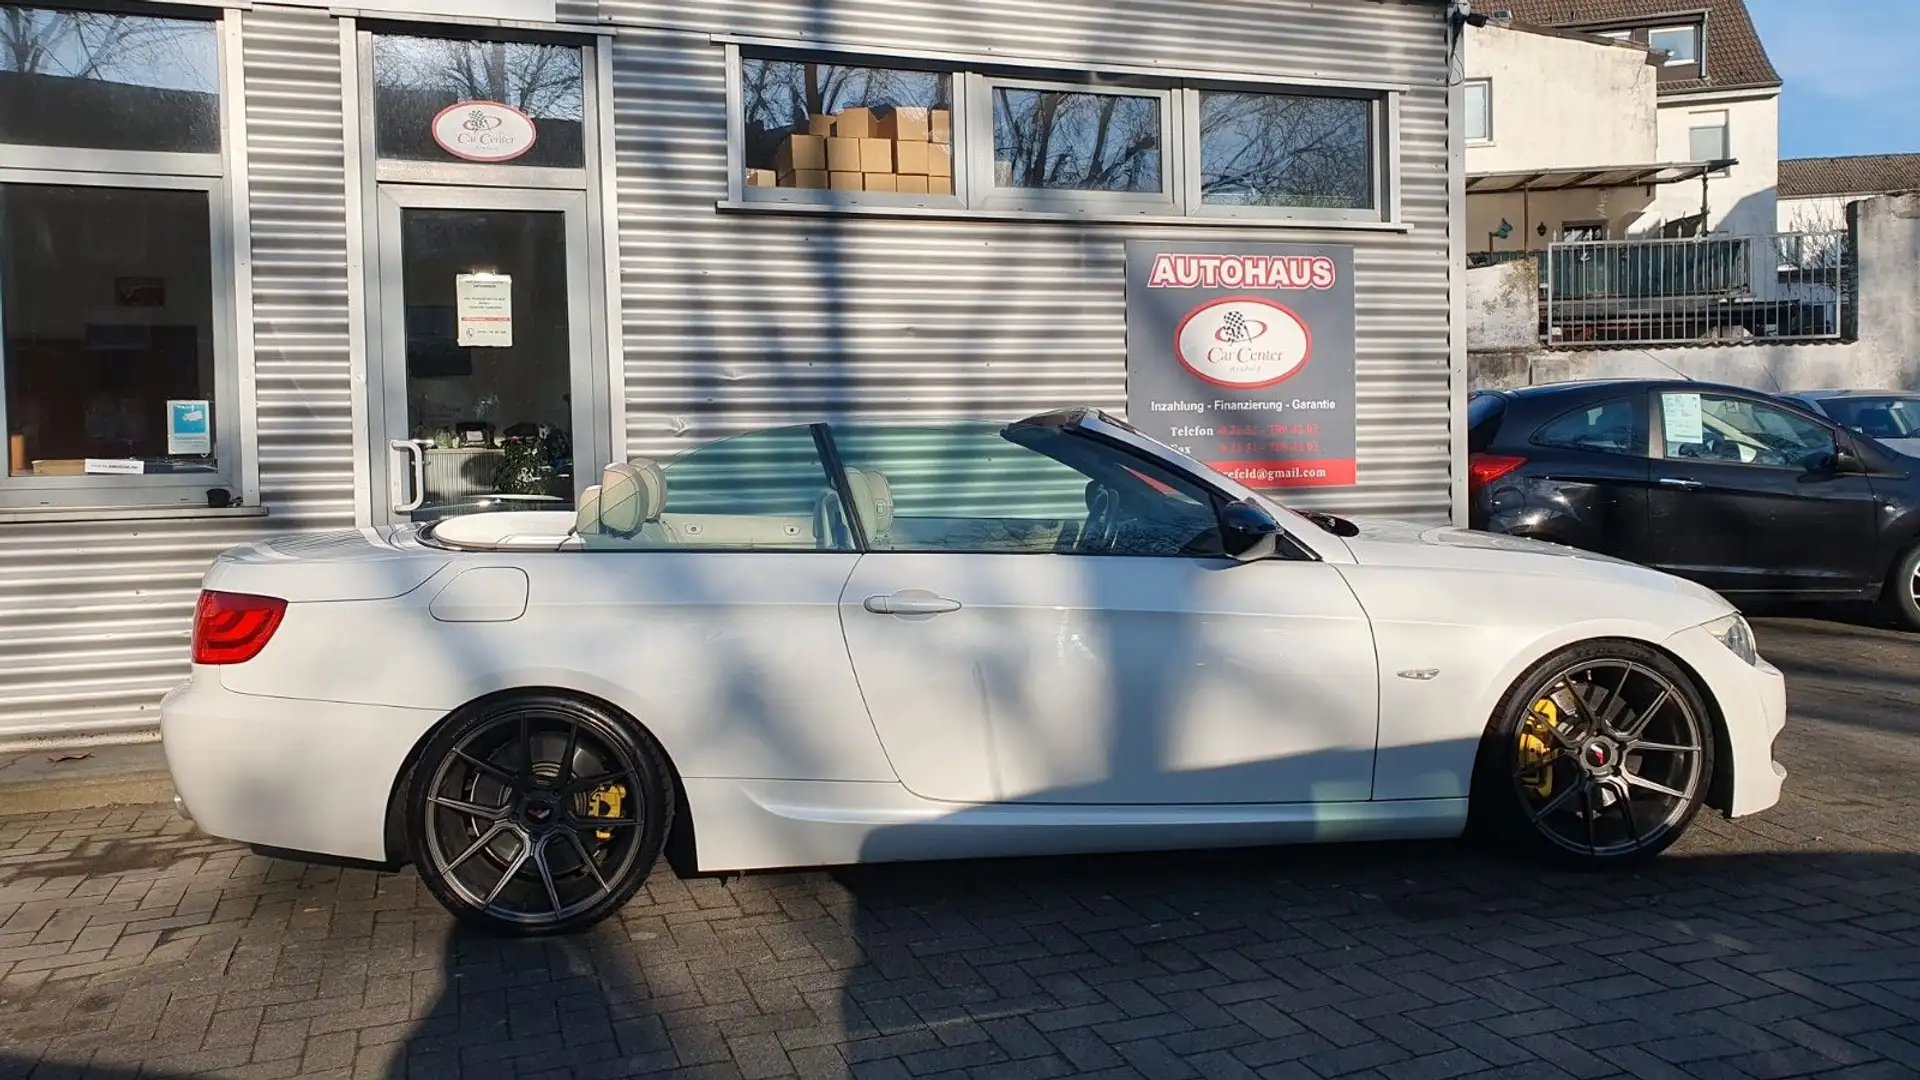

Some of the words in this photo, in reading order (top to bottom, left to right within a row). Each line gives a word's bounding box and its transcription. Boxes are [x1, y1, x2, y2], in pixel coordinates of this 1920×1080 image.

[1149, 255, 1335, 289] AUTOHAUS
[1207, 347, 1232, 364] Car
[1237, 347, 1284, 364] Center
[1151, 401, 1204, 413] Inzahlung
[1214, 400, 1283, 412] Finanzierung
[1292, 399, 1336, 410] Garantie
[1170, 425, 1214, 437] Telefon
